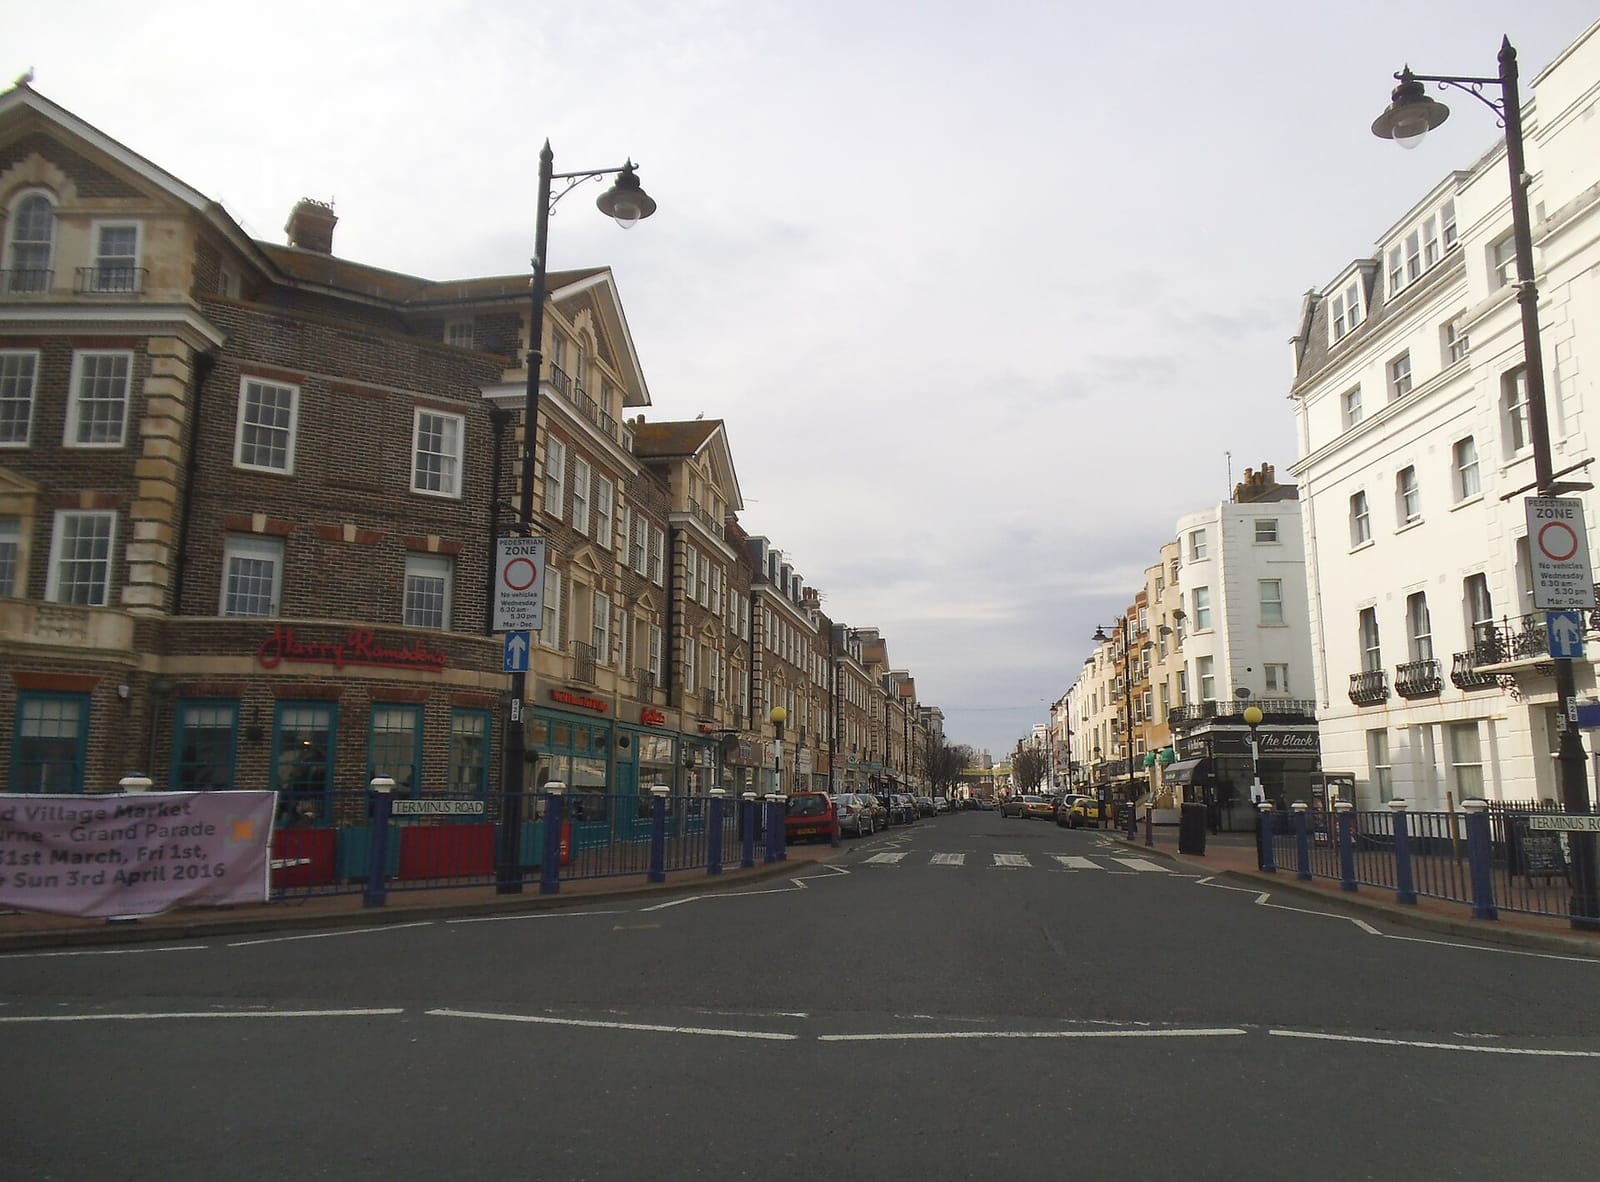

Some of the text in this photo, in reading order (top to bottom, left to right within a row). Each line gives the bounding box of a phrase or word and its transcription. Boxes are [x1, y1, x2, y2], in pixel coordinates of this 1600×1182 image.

[1529, 500, 1579, 508] PEDESTRIAN
[1536, 508, 1574, 519] ZONE
[505, 546, 536, 556] ZONE
[1553, 562, 1583, 570] vehicles
[1541, 572, 1583, 580] Wednesday
[258, 625, 346, 672] Harry
[1260, 734, 1280, 746] The
[1282, 734, 1314, 746] Black
[394, 801, 484, 813] TERMINUS ROAD
[24, 805, 108, 825] Village
[114, 802, 192, 819] Market
[1532, 817, 1584, 829] TERMINUS
[70, 823, 138, 842] Grand
[145, 821, 216, 839] Parade
[50, 848, 128, 866] March,
[137, 845, 164, 861] Fri
[170, 844, 207, 860] 1st,
[14, 871, 59, 888] Sun
[66, 870, 104, 886] 3rd
[113, 865, 166, 887] April
[173, 863, 225, 880] 2016
